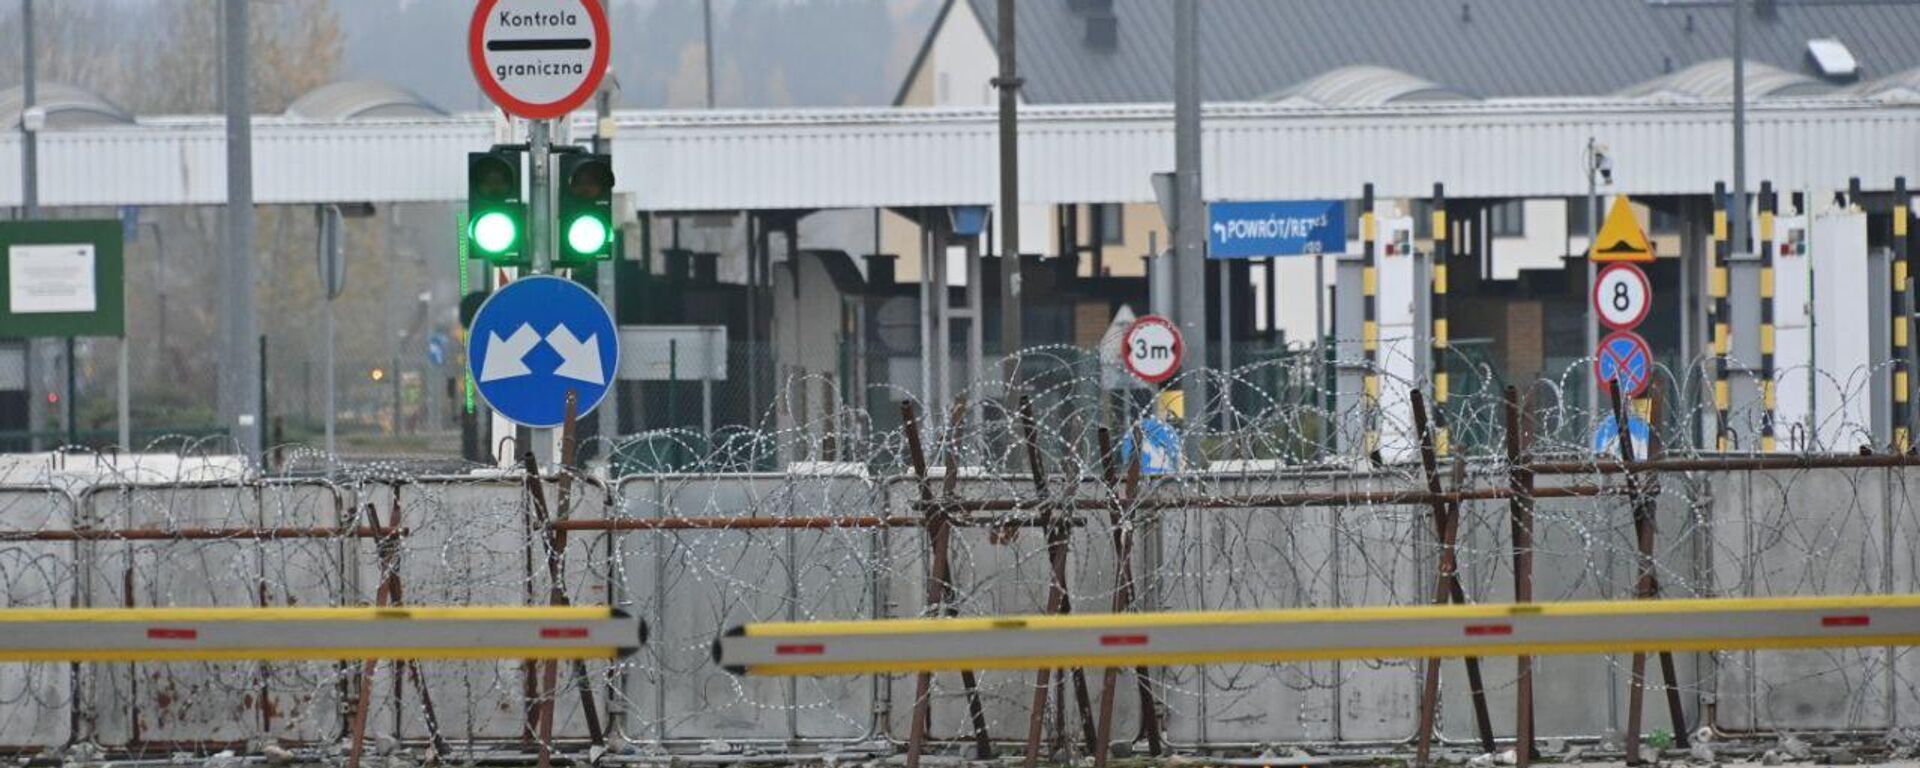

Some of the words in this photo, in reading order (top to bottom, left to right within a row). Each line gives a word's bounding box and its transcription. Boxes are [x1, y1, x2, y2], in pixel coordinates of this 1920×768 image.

[500, 10, 577, 27] Kontrola
[496, 60, 583, 80] graniczna
[1613, 281, 1630, 312] 8
